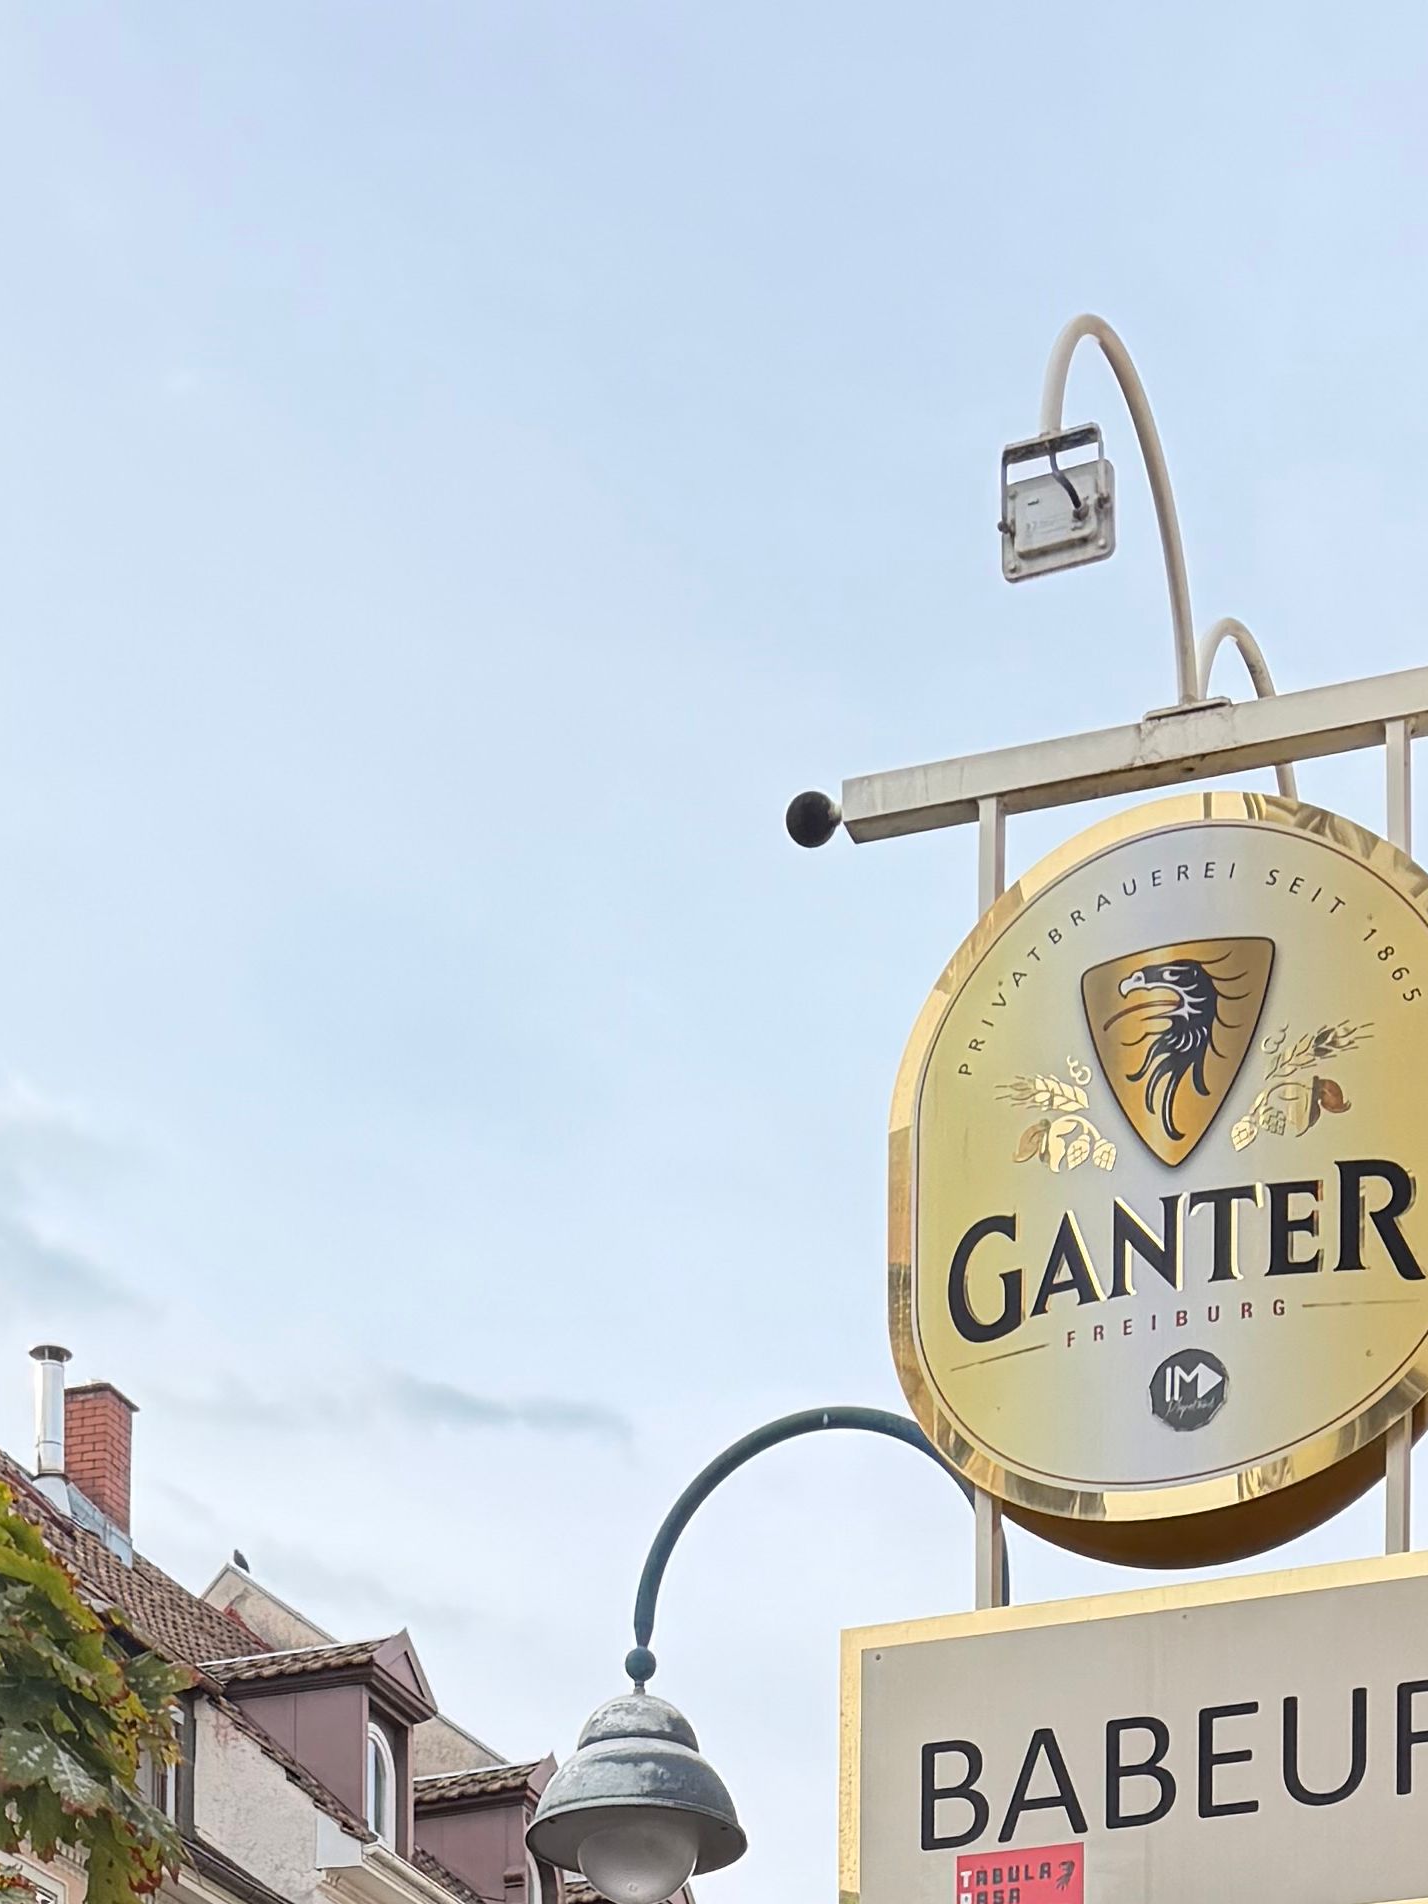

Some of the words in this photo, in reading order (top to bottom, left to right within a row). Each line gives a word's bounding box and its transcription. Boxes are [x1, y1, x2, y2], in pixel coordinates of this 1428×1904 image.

[958, 862, 1236, 1076] PRIVATBRAUEREI
[1265, 868, 1347, 915] SEIT
[1360, 925, 1423, 1003] 1865
[948, 1158, 1427, 1344] GANTER
[1067, 1299, 1287, 1348] FREIBURG
[959, 1861, 1052, 1889] TABULA
